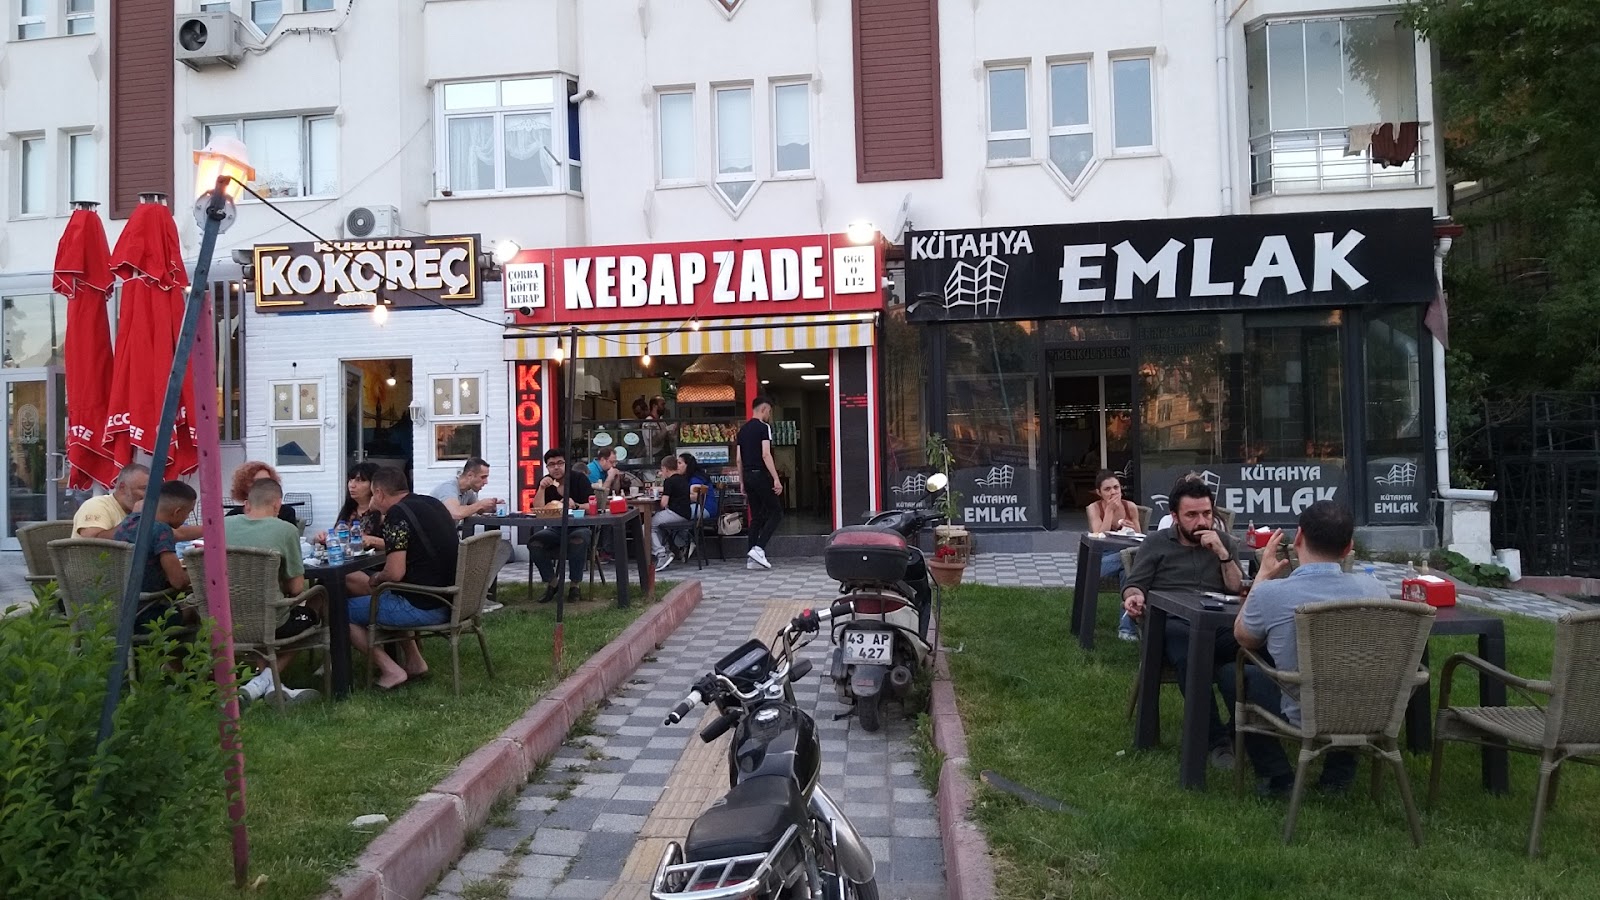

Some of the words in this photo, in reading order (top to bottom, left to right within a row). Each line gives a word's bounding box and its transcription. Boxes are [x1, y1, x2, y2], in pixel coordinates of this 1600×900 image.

[911, 229, 1034, 261] KÜTAHYA
[262, 247, 469, 295] KOKOREÇ
[1058, 228, 1370, 304] EMLAK
[508, 270, 539, 282] ÇORBA
[845, 277, 864, 286] 112
[510, 281, 539, 293] KÖFTE
[510, 294, 540, 304] KEBAP
[1240, 464, 1321, 482] KÜTAHYA
[972, 494, 1017, 504] KÜTAHYA
[1226, 486, 1338, 516] EMLAK
[1380, 494, 1412, 502] KÜTAHYA
[1374, 502, 1419, 514] EMLAK
[964, 506, 1028, 524] EMLAK
[847, 633, 864, 645] 43
[872, 634, 890, 645] AP
[858, 648, 885, 659] 427
